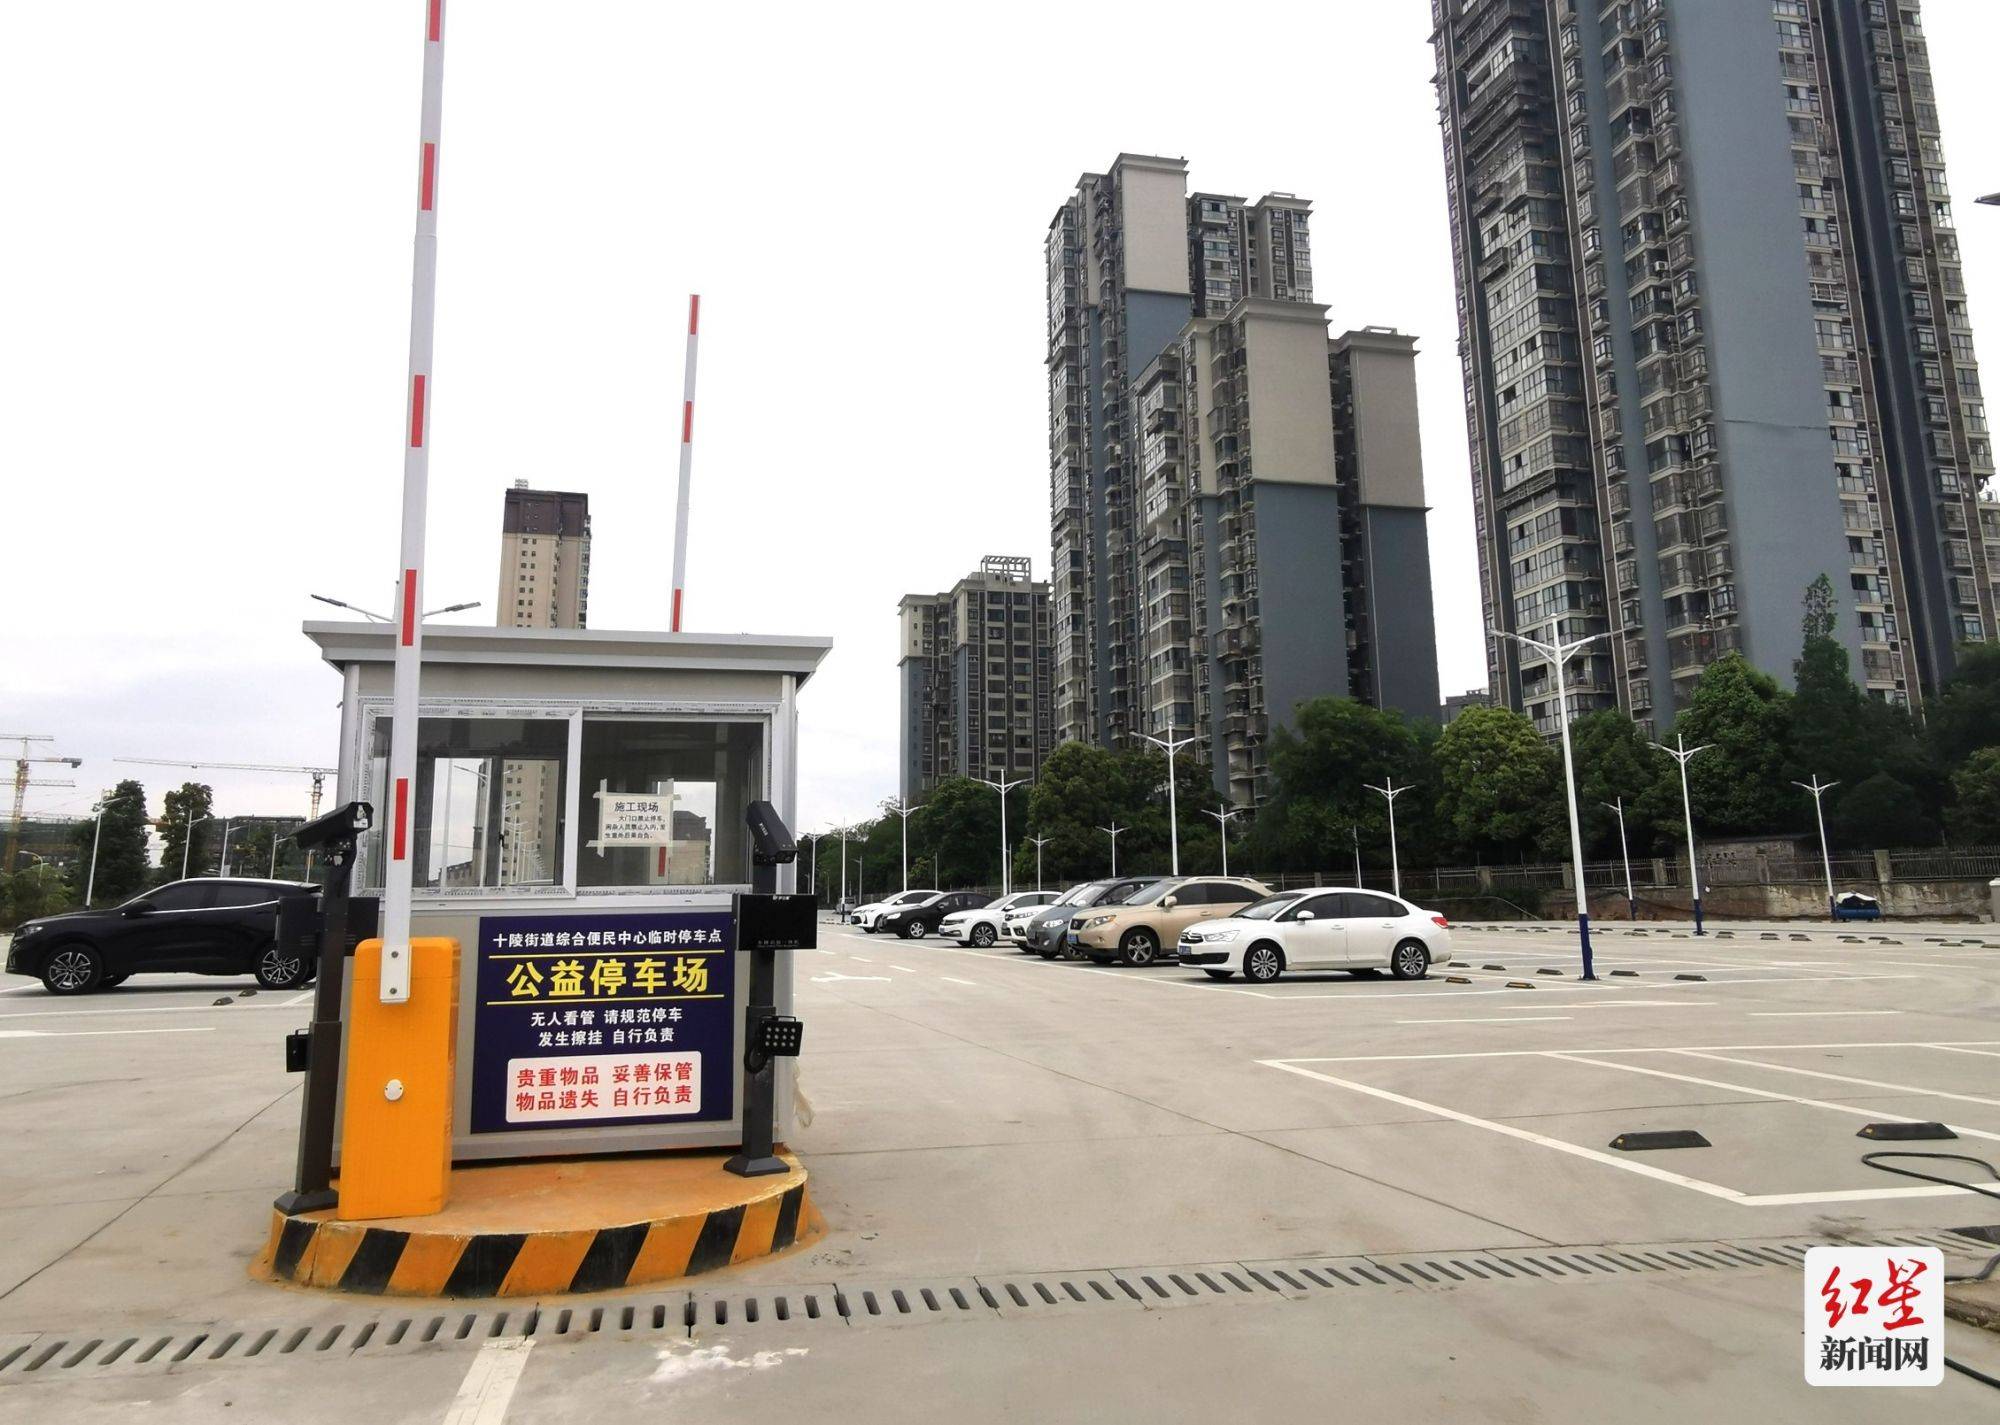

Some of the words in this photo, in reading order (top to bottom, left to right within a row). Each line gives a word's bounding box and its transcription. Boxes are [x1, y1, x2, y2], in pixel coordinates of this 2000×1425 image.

[615, 802, 658, 812] 施工现场
[493, 928, 722, 949] 十陵街道综合便民中心临时停车点
[506, 956, 709, 998] 公益停车场
[530, 1009, 595, 1027] 无人看管
[603, 1007, 683, 1025] 请规范停车
[538, 1030, 603, 1047] 发生擦挂
[612, 1027, 675, 1044] 自行负责
[516, 1065, 599, 1088] 贵重物品
[612, 1062, 693, 1084] 妥善保管
[516, 1089, 599, 1112] 物品遗失
[613, 1085, 693, 1107] 自行负责
